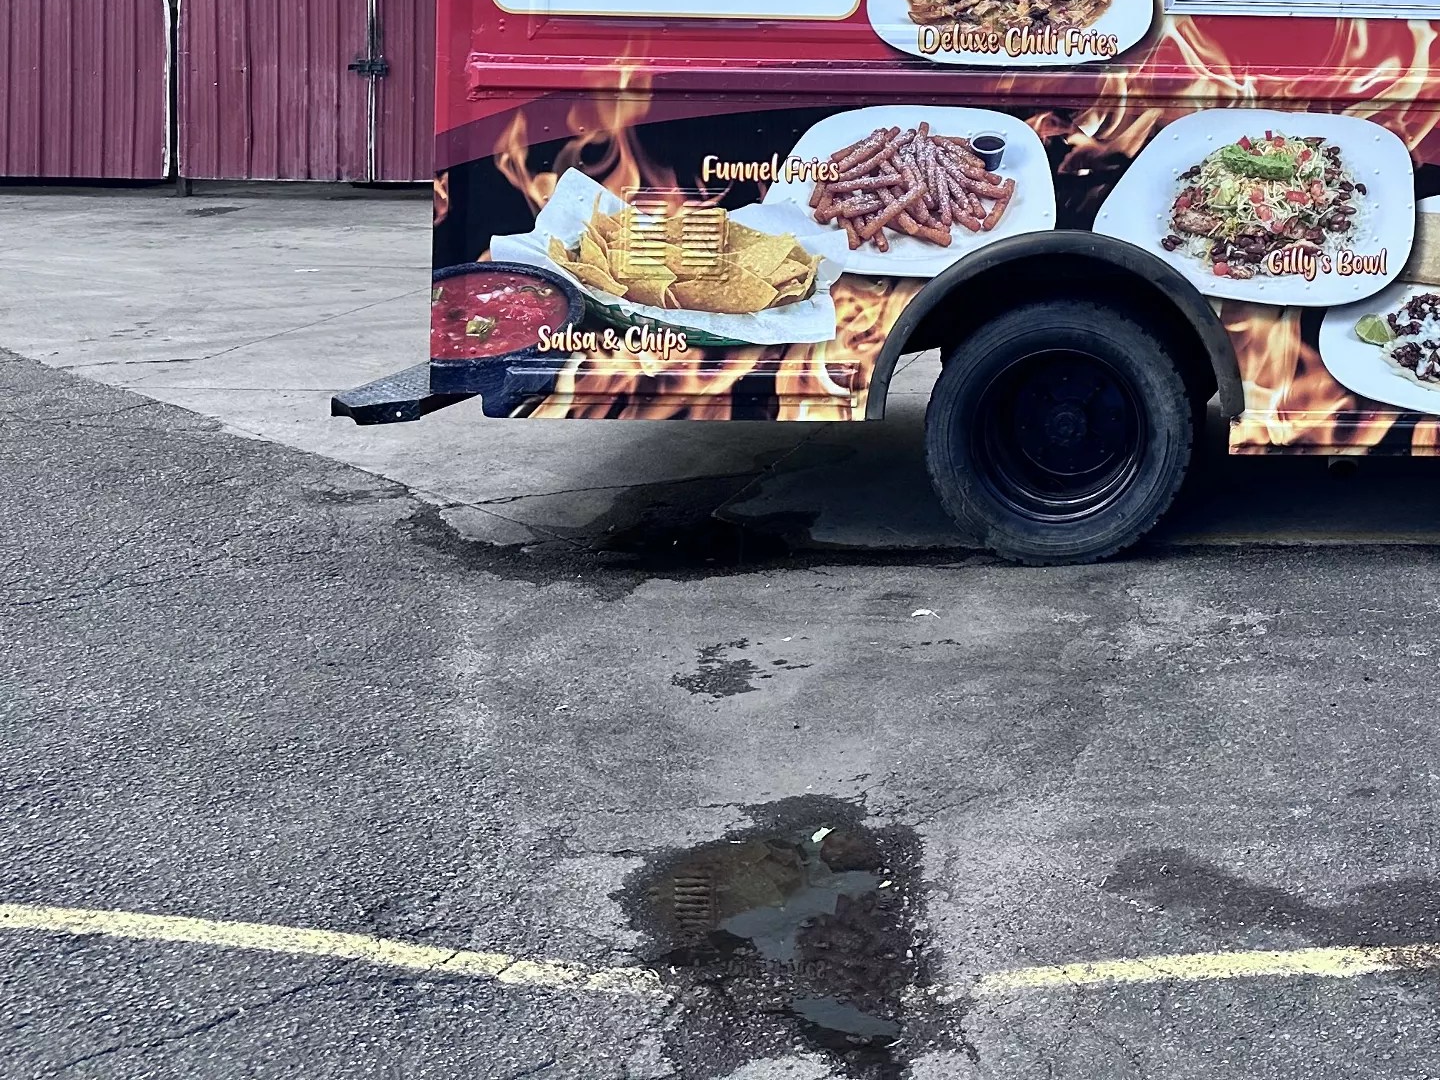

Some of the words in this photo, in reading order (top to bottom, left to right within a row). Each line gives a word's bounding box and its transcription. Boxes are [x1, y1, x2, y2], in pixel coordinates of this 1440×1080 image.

[918, 25, 998, 54] Deluxe
[1004, 25, 1058, 57] Chili
[1065, 29, 1118, 57] Fries
[702, 154, 779, 184] Funnel
[785, 156, 839, 184] Fries
[1267, 248, 1332, 281] Gilly's
[1337, 249, 1387, 276] Bowl
[538, 325, 598, 352] Salsa
[603, 330, 620, 351] &
[625, 326, 688, 359] Chips
